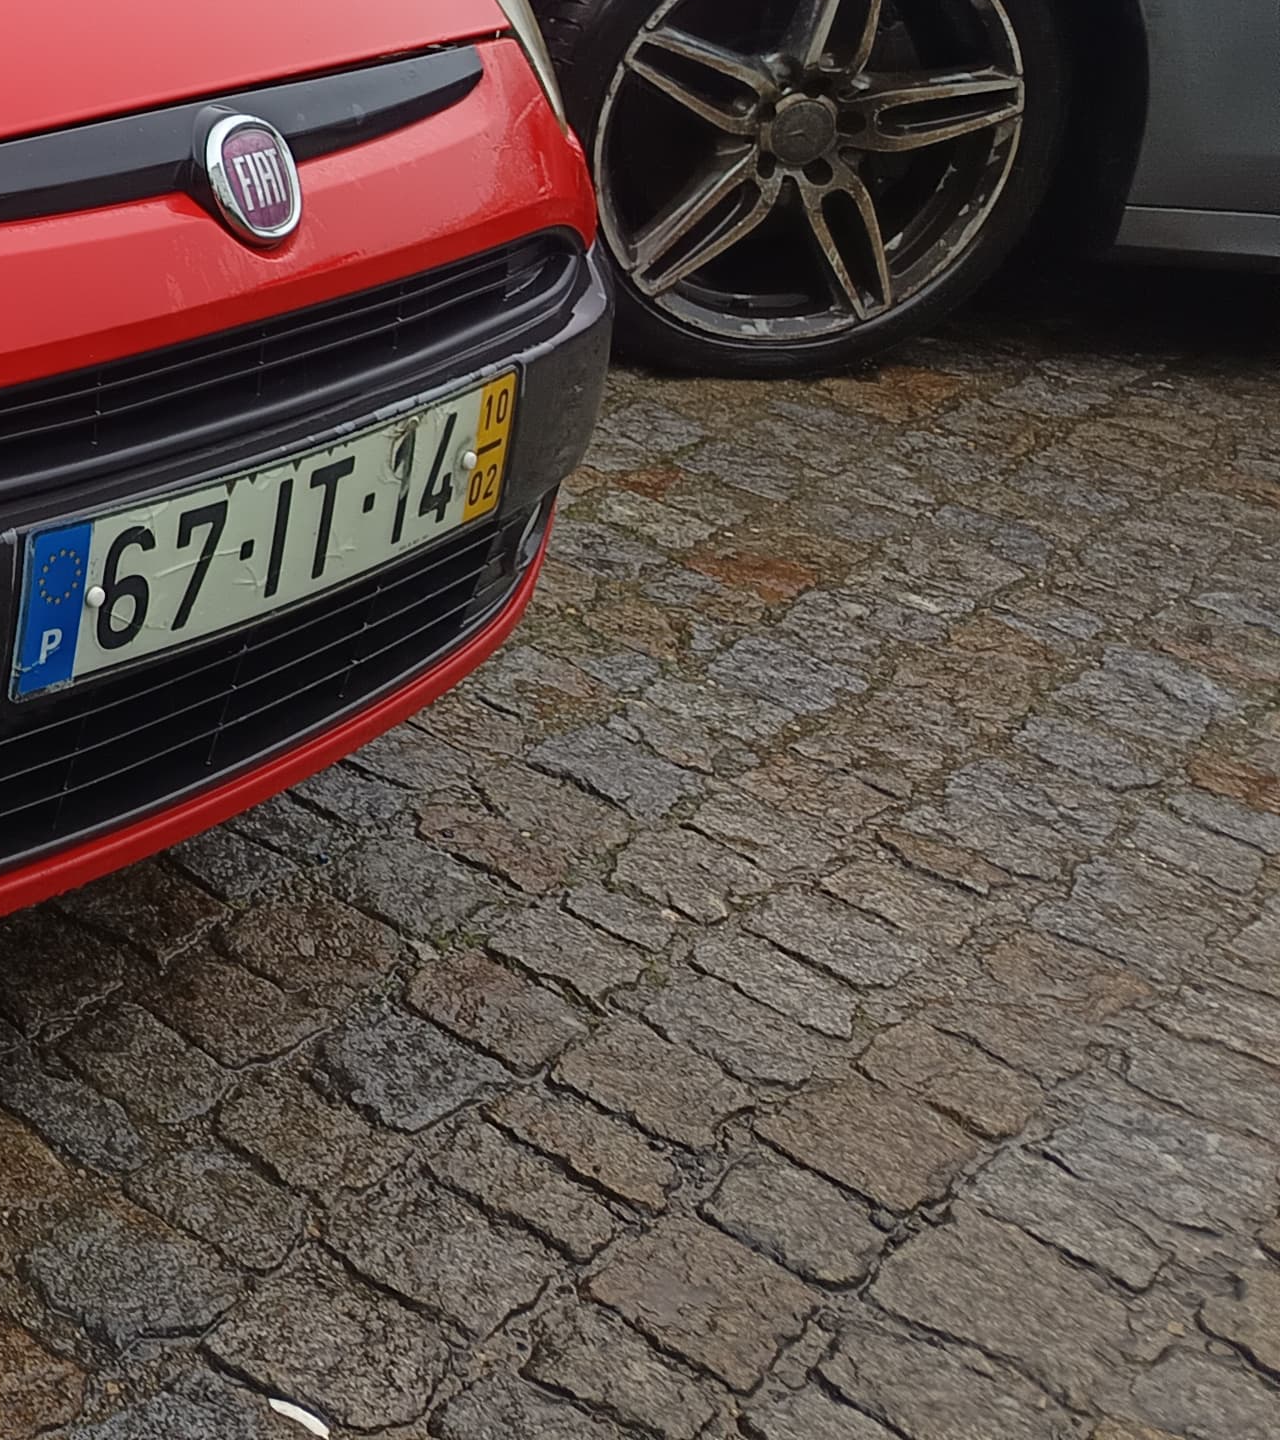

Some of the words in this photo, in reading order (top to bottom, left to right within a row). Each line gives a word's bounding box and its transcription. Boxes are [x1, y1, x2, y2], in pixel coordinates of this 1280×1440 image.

[231, 147, 287, 212] FIAT
[483, 388, 510, 433] 10
[468, 464, 496, 507] 02
[39, 628, 63, 664] P
